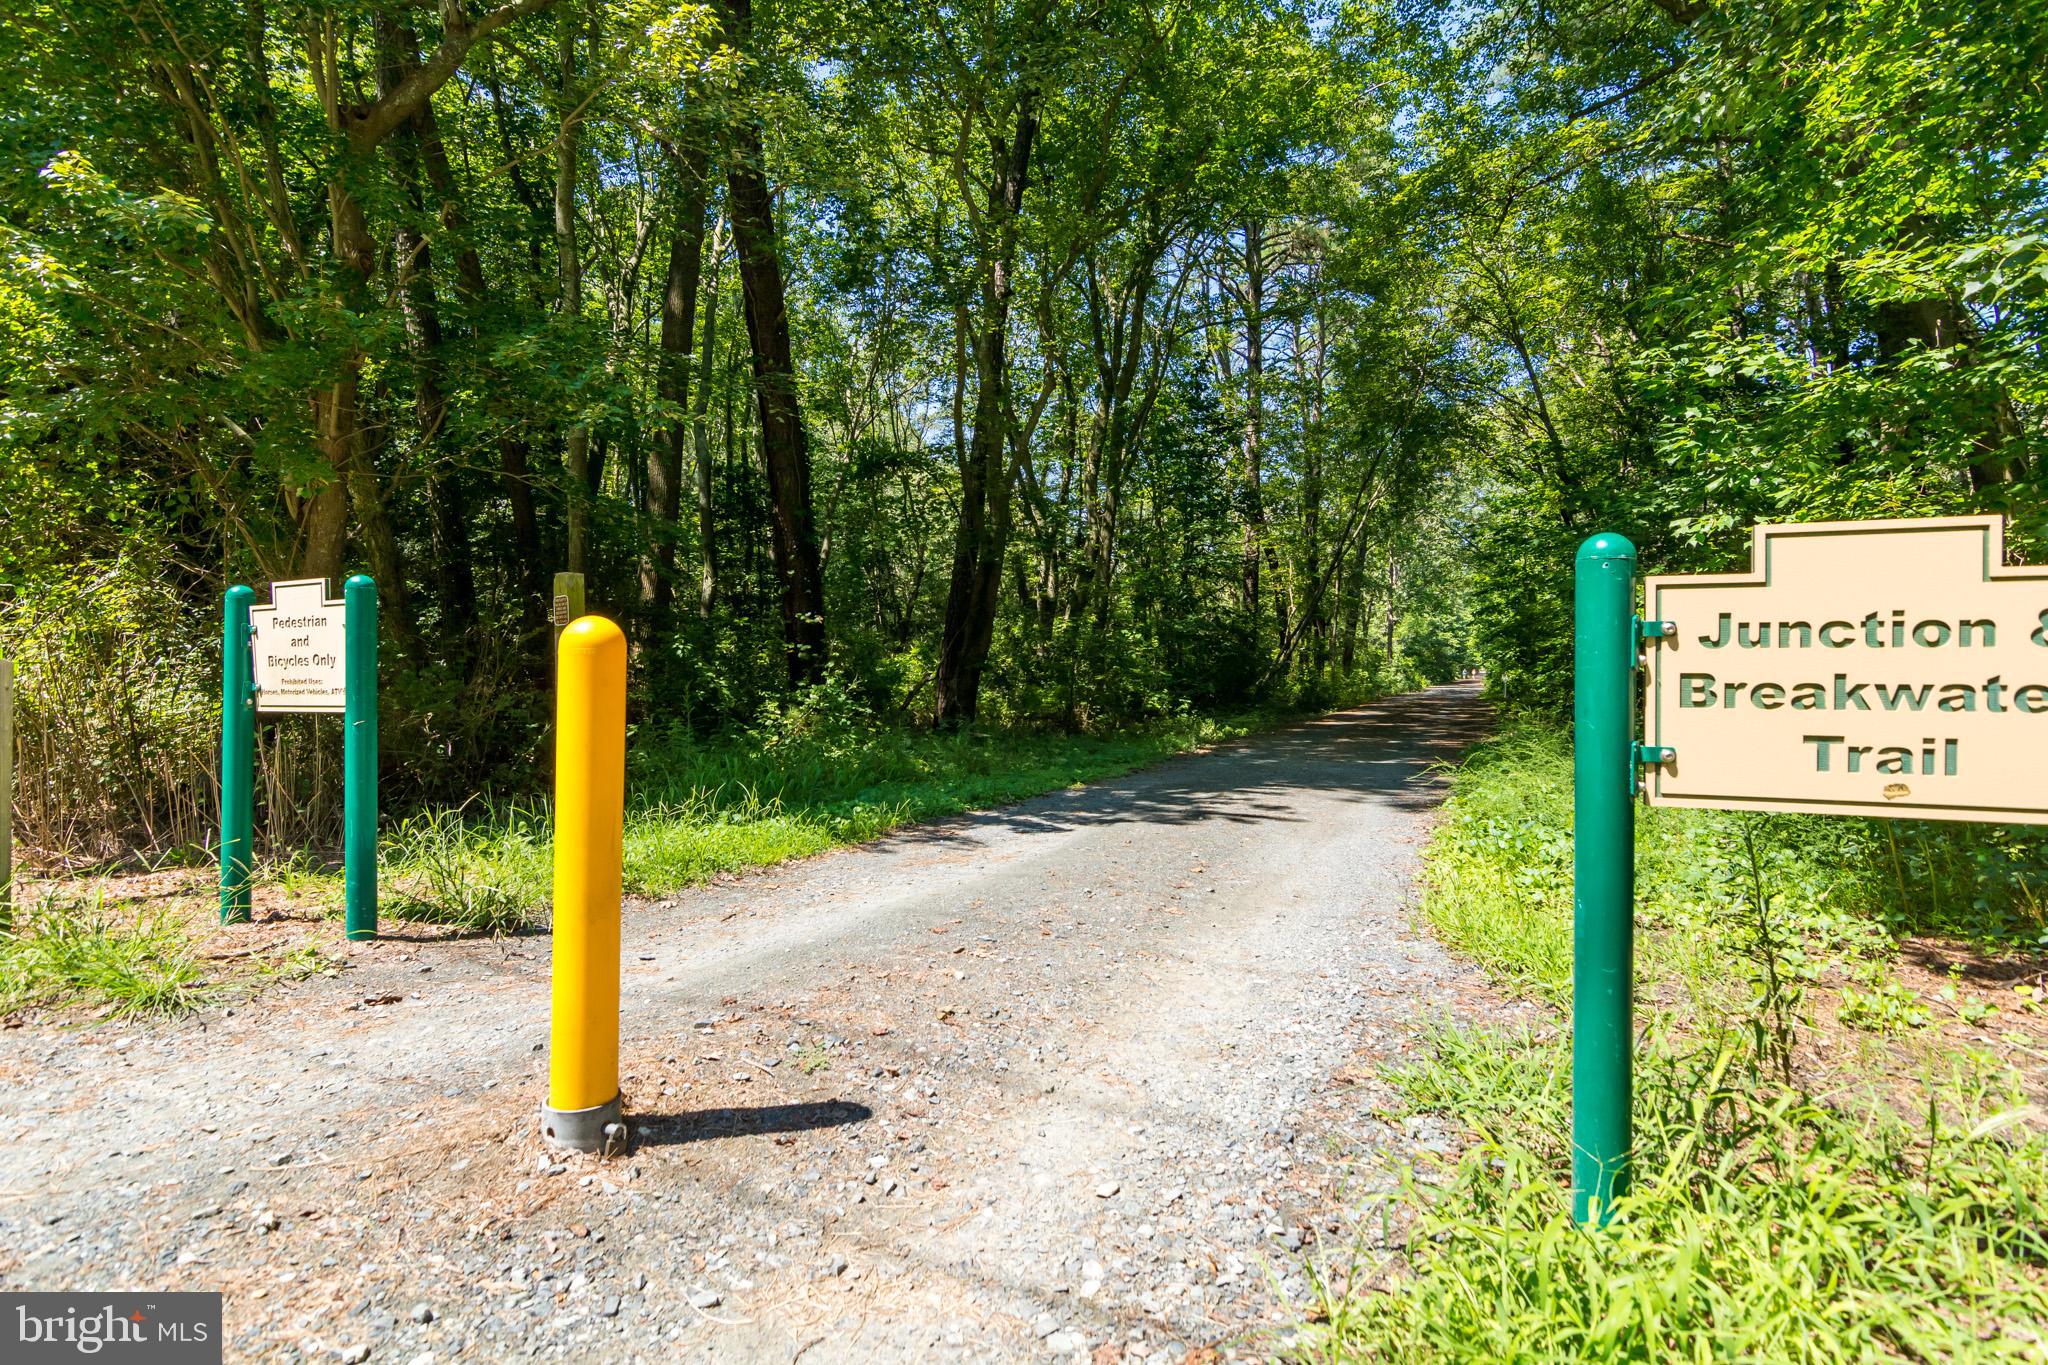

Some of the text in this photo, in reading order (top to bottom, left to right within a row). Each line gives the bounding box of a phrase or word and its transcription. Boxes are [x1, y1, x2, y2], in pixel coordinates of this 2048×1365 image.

[273, 615, 327, 629] Pedestrian
[1698, 610, 1997, 649] Junction
[291, 635, 309, 647] and
[268, 653, 336, 670] Bicycles Only
[281, 687, 305, 696] Motorized
[1803, 734, 1959, 777] Trail
